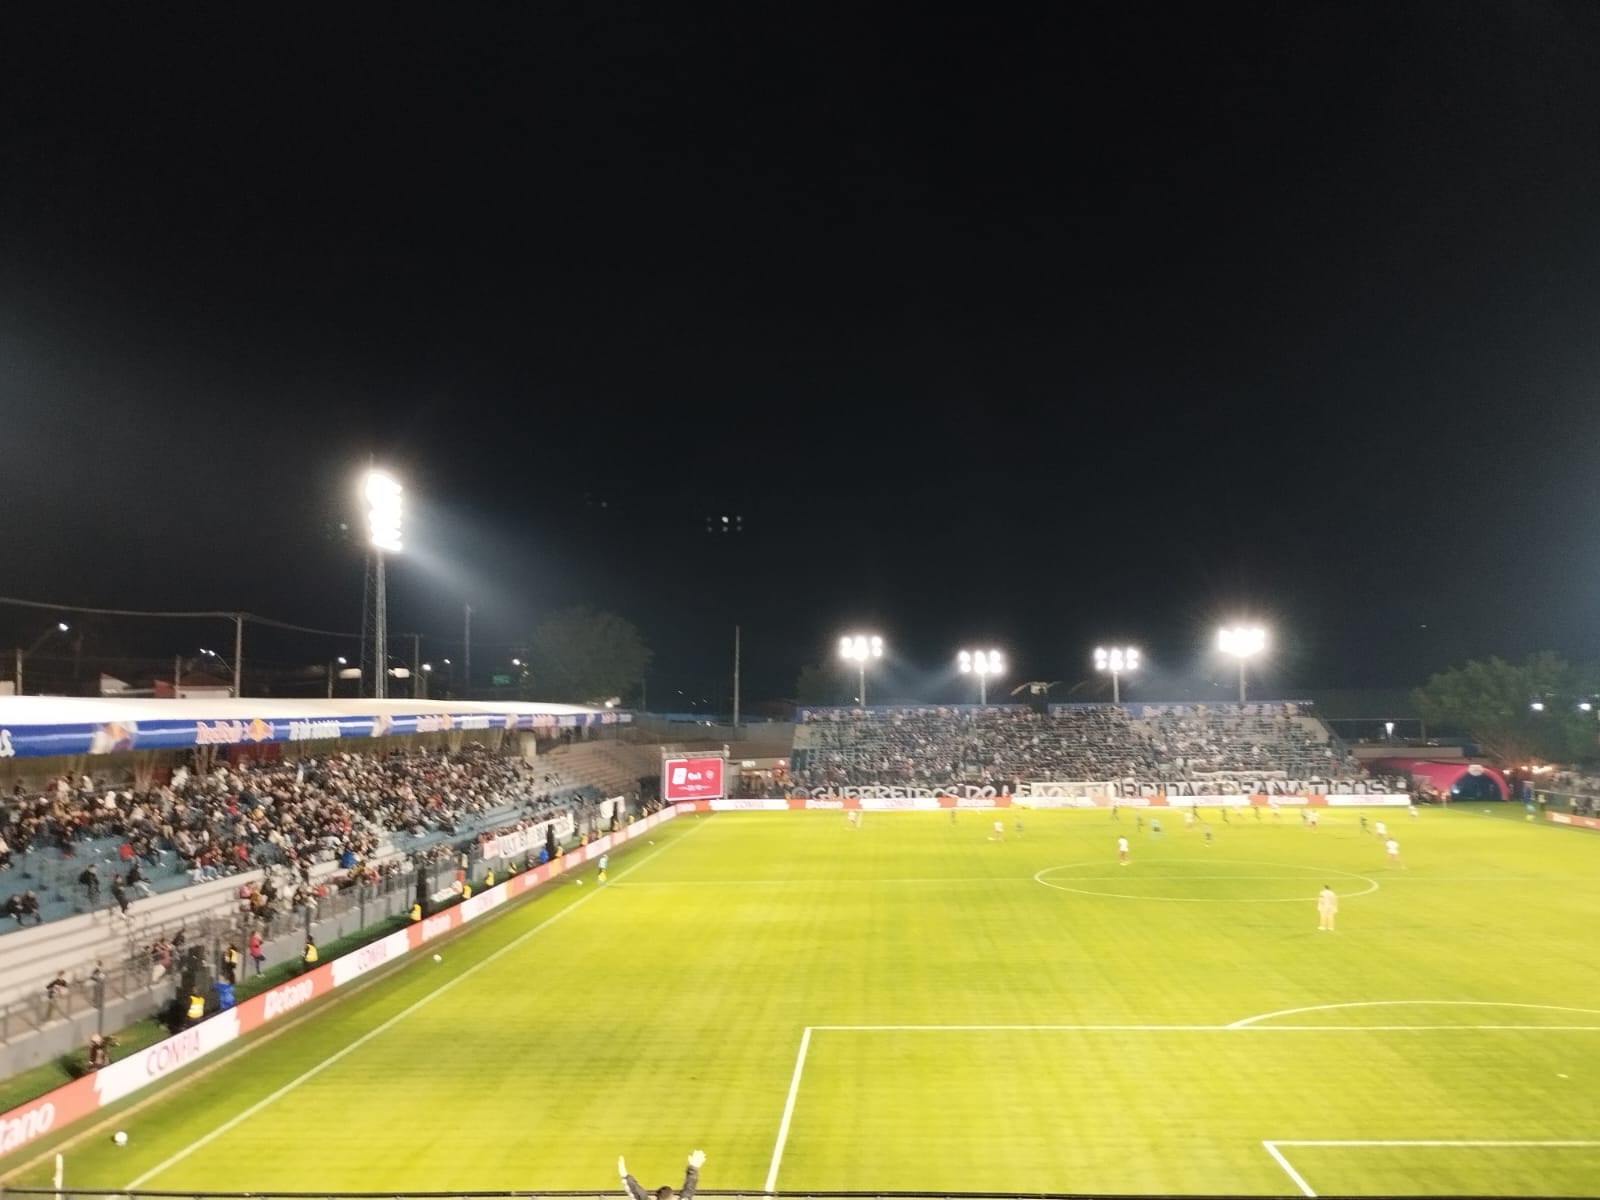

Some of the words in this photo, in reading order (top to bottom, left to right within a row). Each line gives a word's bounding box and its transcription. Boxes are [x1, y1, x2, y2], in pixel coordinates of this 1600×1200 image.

[812, 784, 958, 800] GUERREIROS
[146, 1030, 200, 1076] CONFIA
[264, 979, 313, 1019] Betano
